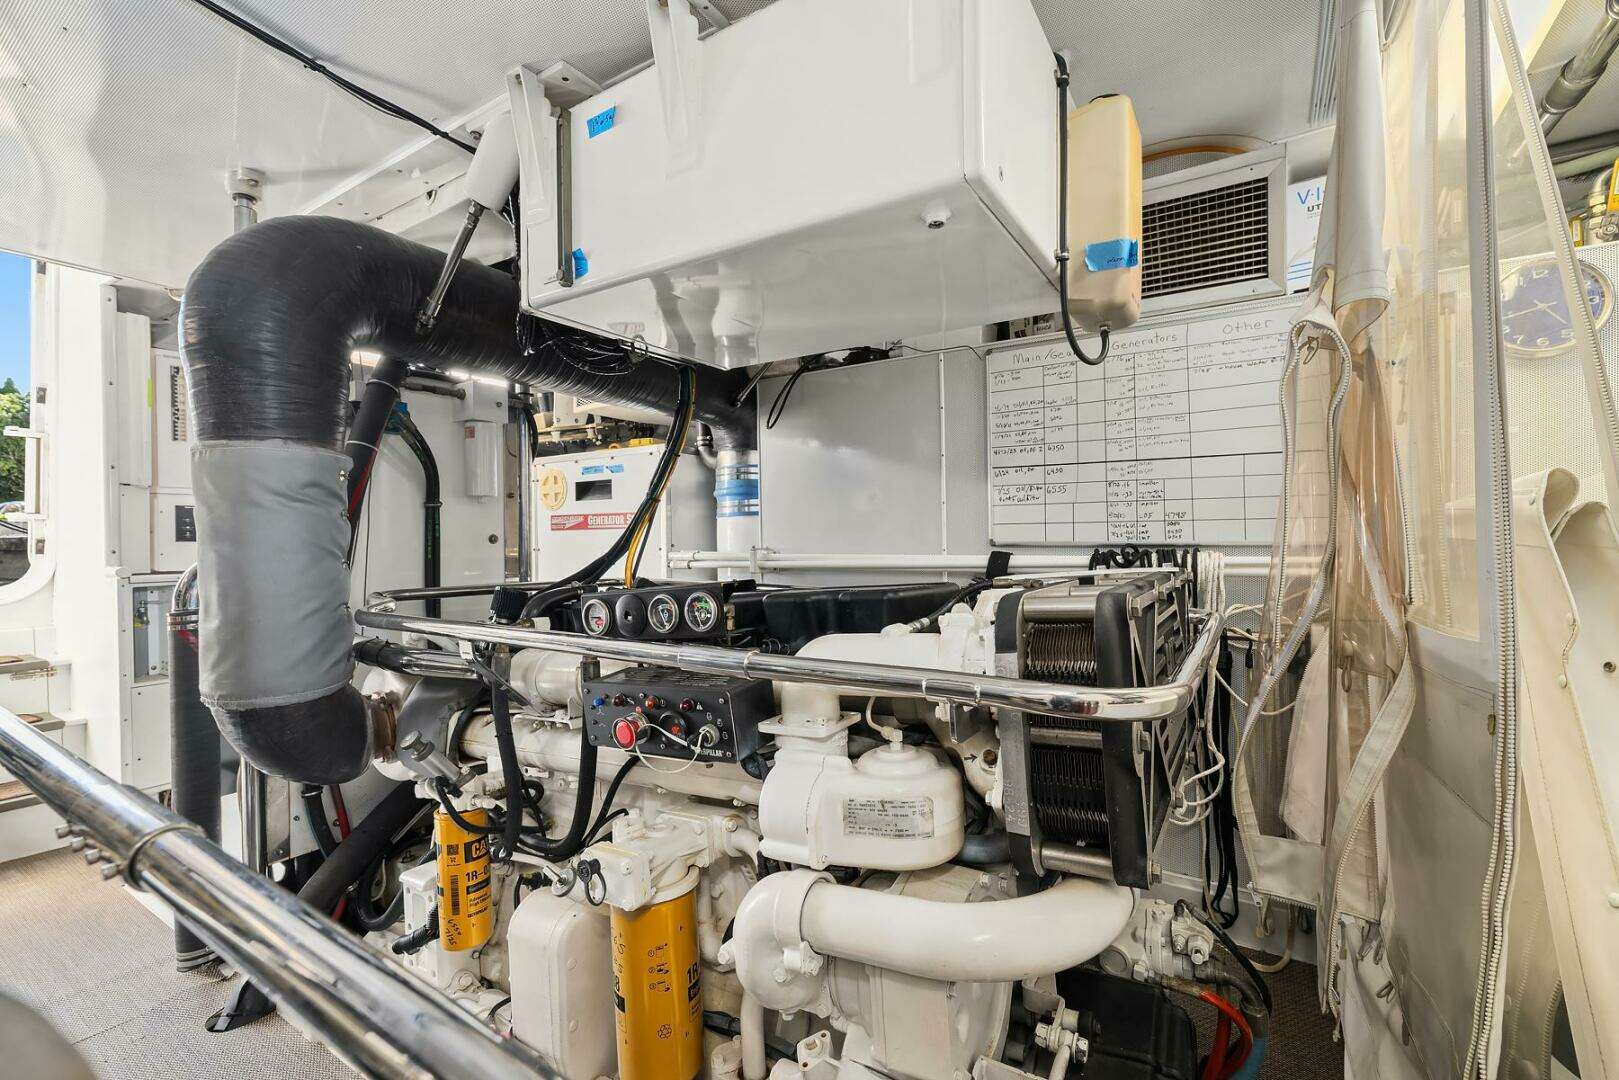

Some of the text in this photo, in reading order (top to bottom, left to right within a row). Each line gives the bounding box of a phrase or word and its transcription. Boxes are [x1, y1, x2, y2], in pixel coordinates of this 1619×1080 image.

[1222, 319, 1274, 335] Other
[1112, 332, 1178, 350] Generators
[1046, 486, 1067, 494] 6555
[587, 514, 625, 526] GENERATOR
